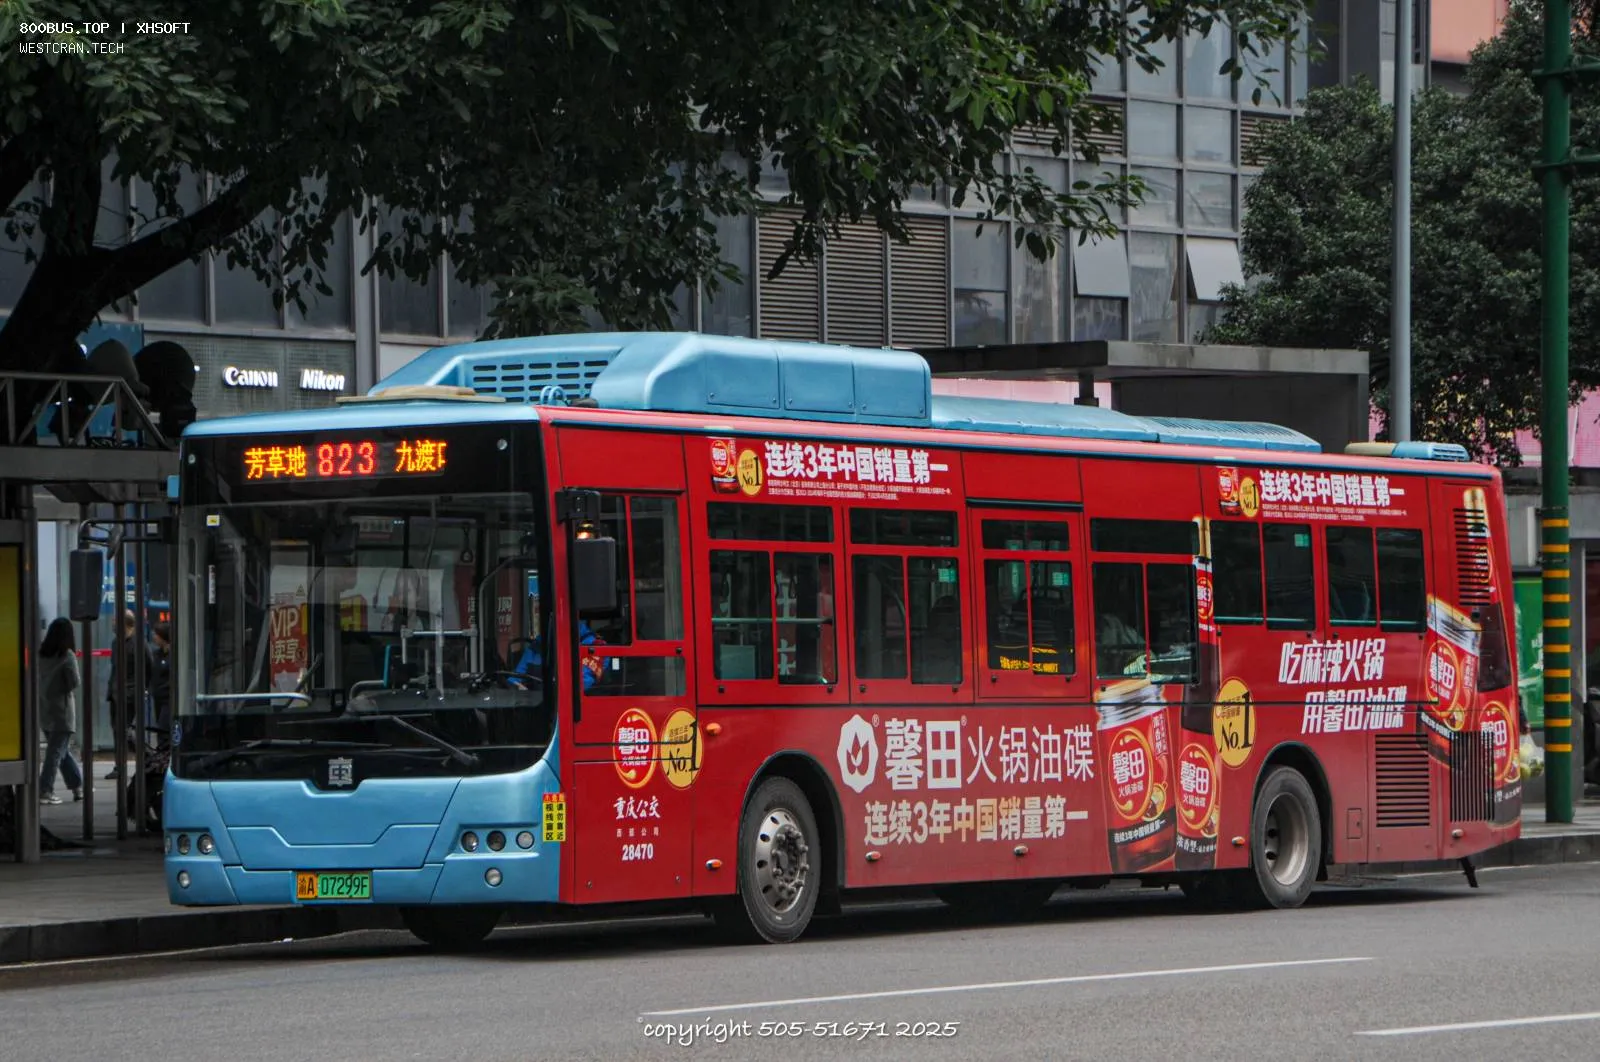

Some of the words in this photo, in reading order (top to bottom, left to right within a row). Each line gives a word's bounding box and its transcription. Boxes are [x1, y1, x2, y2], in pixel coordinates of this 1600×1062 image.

[224, 366, 279, 388] Canon
[302, 368, 346, 391] Nikon
[244, 446, 307, 479] 芳草地
[317, 441, 376, 476] 823
[764, 441, 949, 484] 连续3年中国销量第一
[1259, 470, 1405, 507] 连续3年中国销量第一
[270, 607, 299, 637] VIP
[1278, 638, 1386, 684] 吃麻辣火锅
[1301, 685, 1408, 735] 用馨田油碟
[1112, 747, 1145, 784] 馨田
[1180, 760, 1209, 795] 馨田
[864, 795, 1089, 846] 连续3年中国销量第一
[622, 842, 654, 861] 28470
